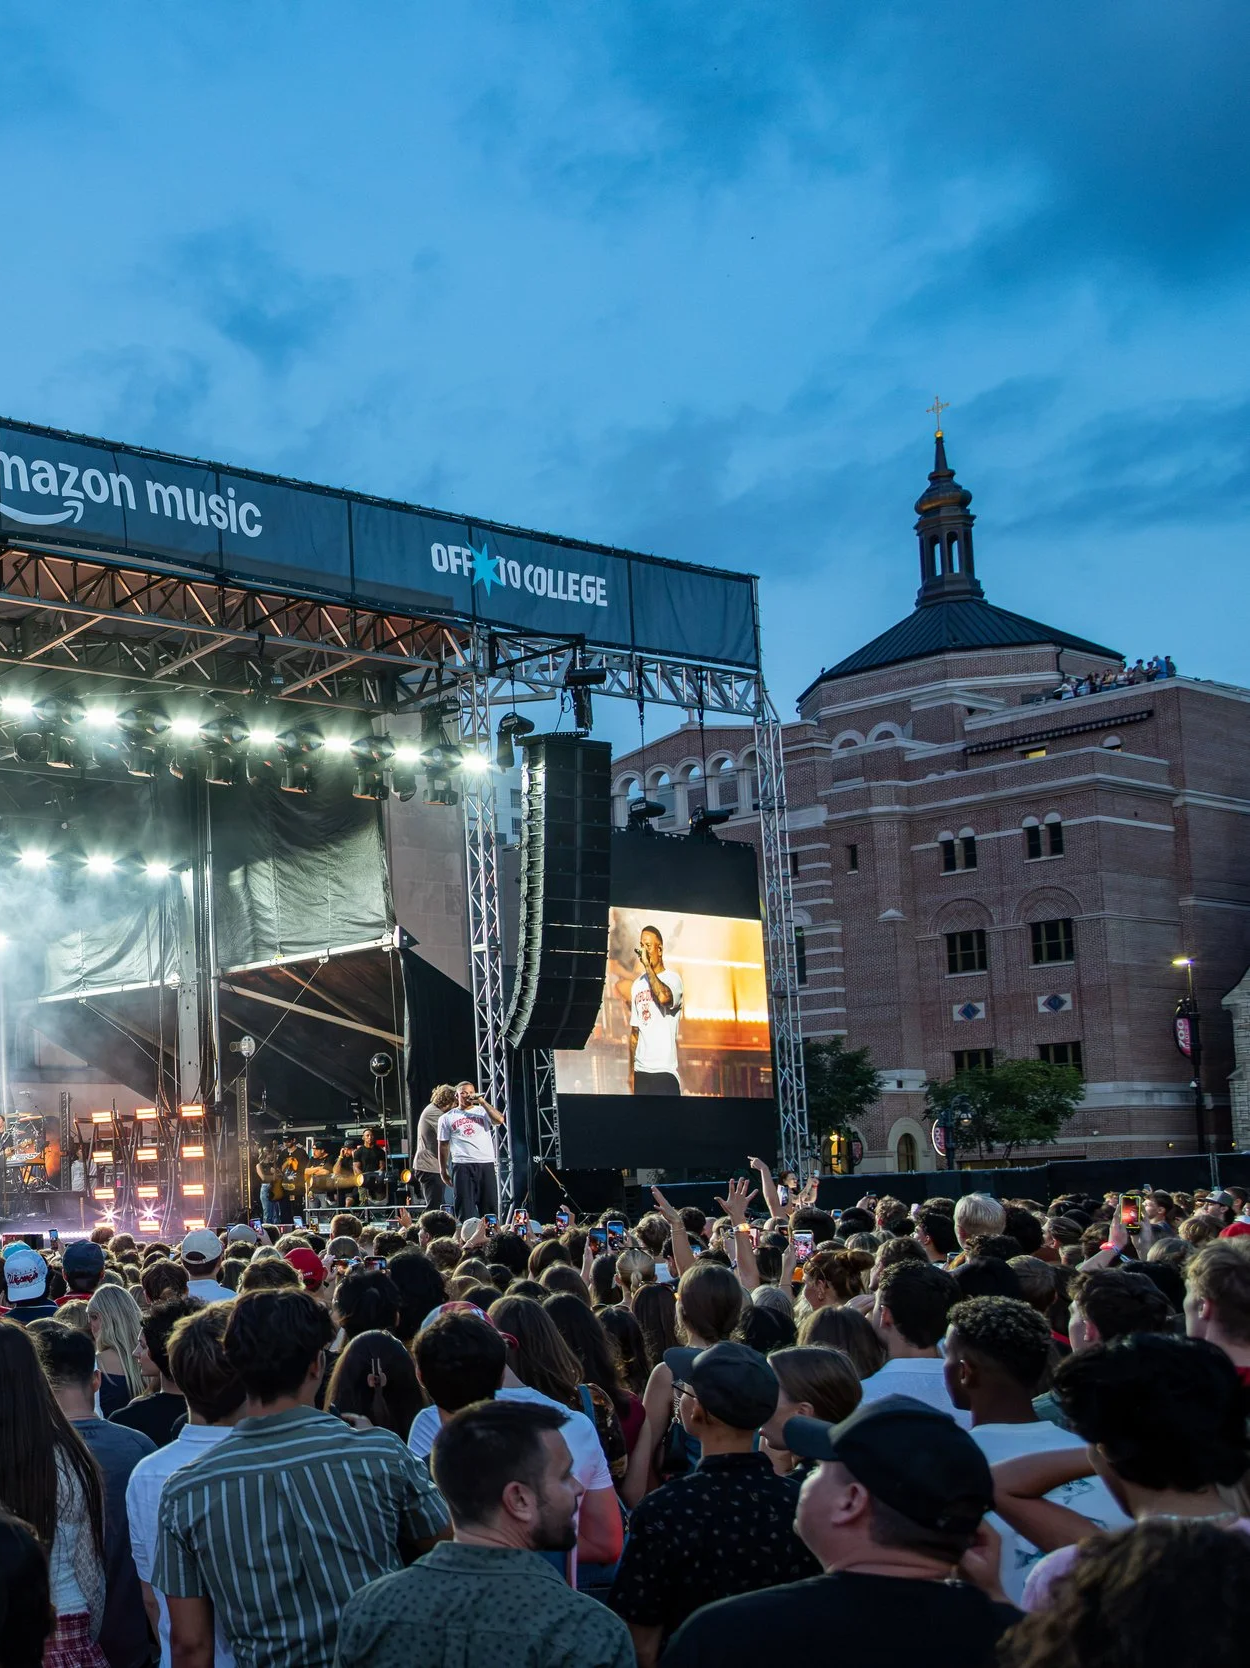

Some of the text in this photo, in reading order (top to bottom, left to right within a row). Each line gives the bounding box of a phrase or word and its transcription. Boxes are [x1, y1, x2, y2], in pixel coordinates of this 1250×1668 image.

[145, 479, 263, 538] music
[430, 542, 608, 607] OFF TO COLLEGE
